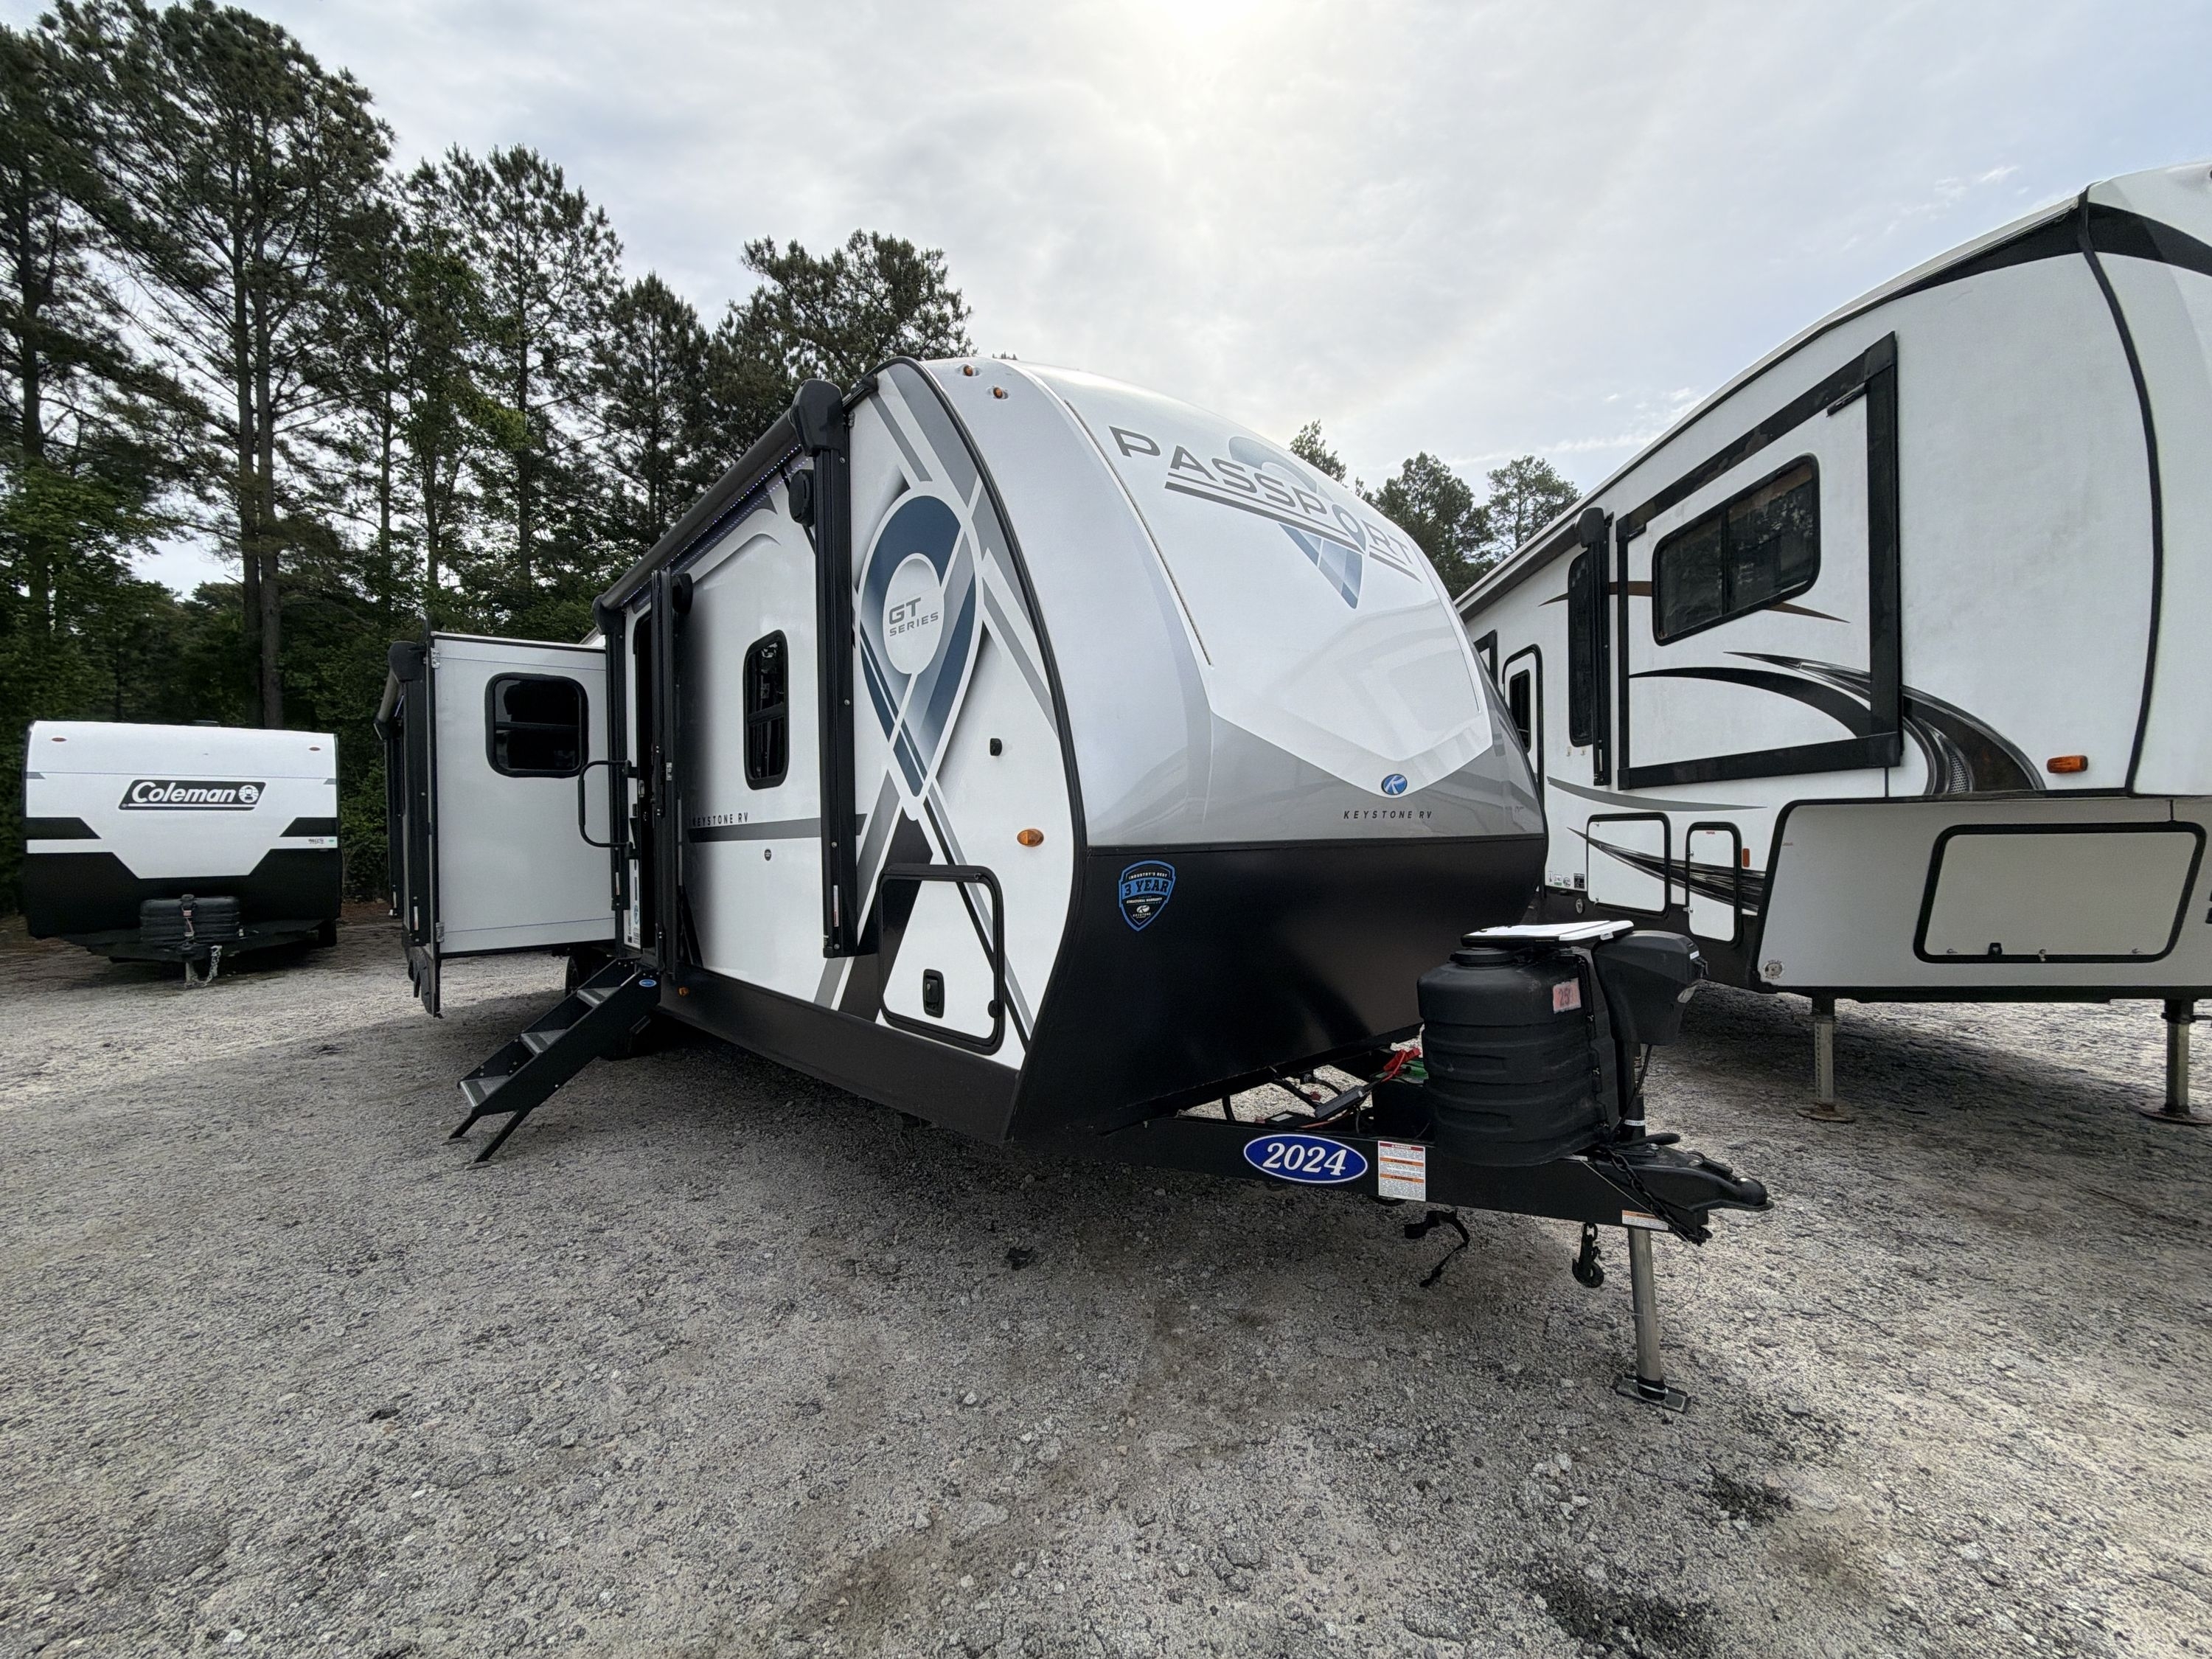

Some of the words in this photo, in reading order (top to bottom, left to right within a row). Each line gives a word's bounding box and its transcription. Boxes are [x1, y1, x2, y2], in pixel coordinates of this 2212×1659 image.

[1108, 425, 1414, 566] PASSPORT
[888, 597, 922, 625] GT
[889, 611, 939, 637] SERIES
[131, 781, 237, 804] Coleman
[738, 812, 748, 824] RV
[1343, 810, 1413, 819] KEYSTONE
[1419, 811, 1433, 819] RV
[1124, 883, 1132, 897] 3
[1135, 880, 1169, 892] YEAR
[1262, 1142, 1348, 1176] 2024
